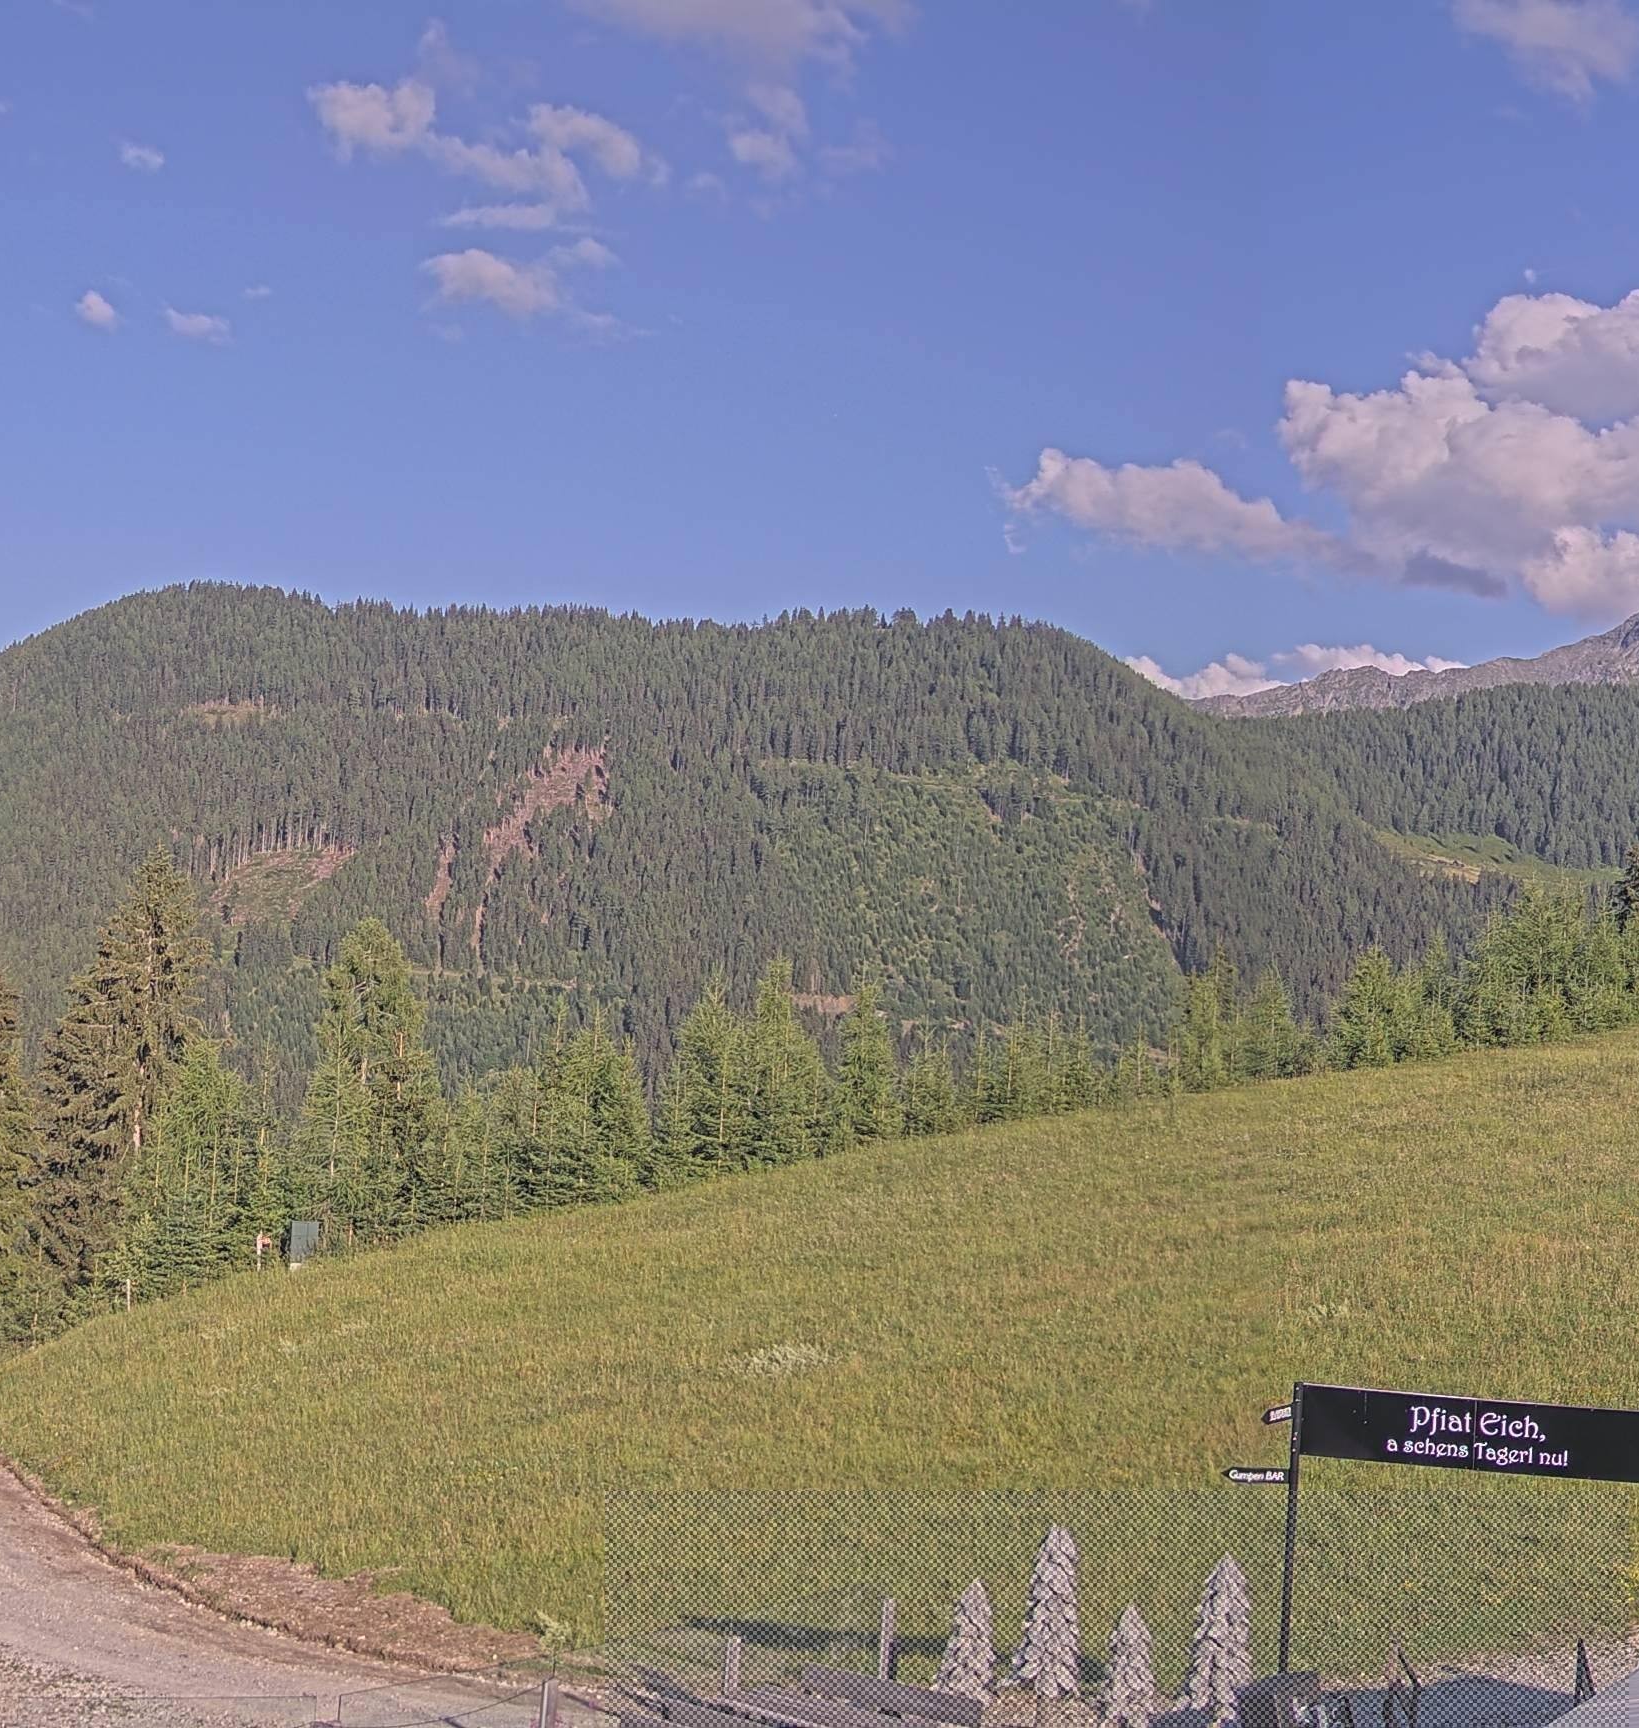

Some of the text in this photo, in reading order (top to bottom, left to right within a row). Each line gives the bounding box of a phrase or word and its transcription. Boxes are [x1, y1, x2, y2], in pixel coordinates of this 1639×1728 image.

[1410, 1406, 1546, 1442] Pfiat Eich,
[1387, 1439, 1568, 1467] a schens Tagerl nu!
[1266, 1471, 1284, 1481] BAR
